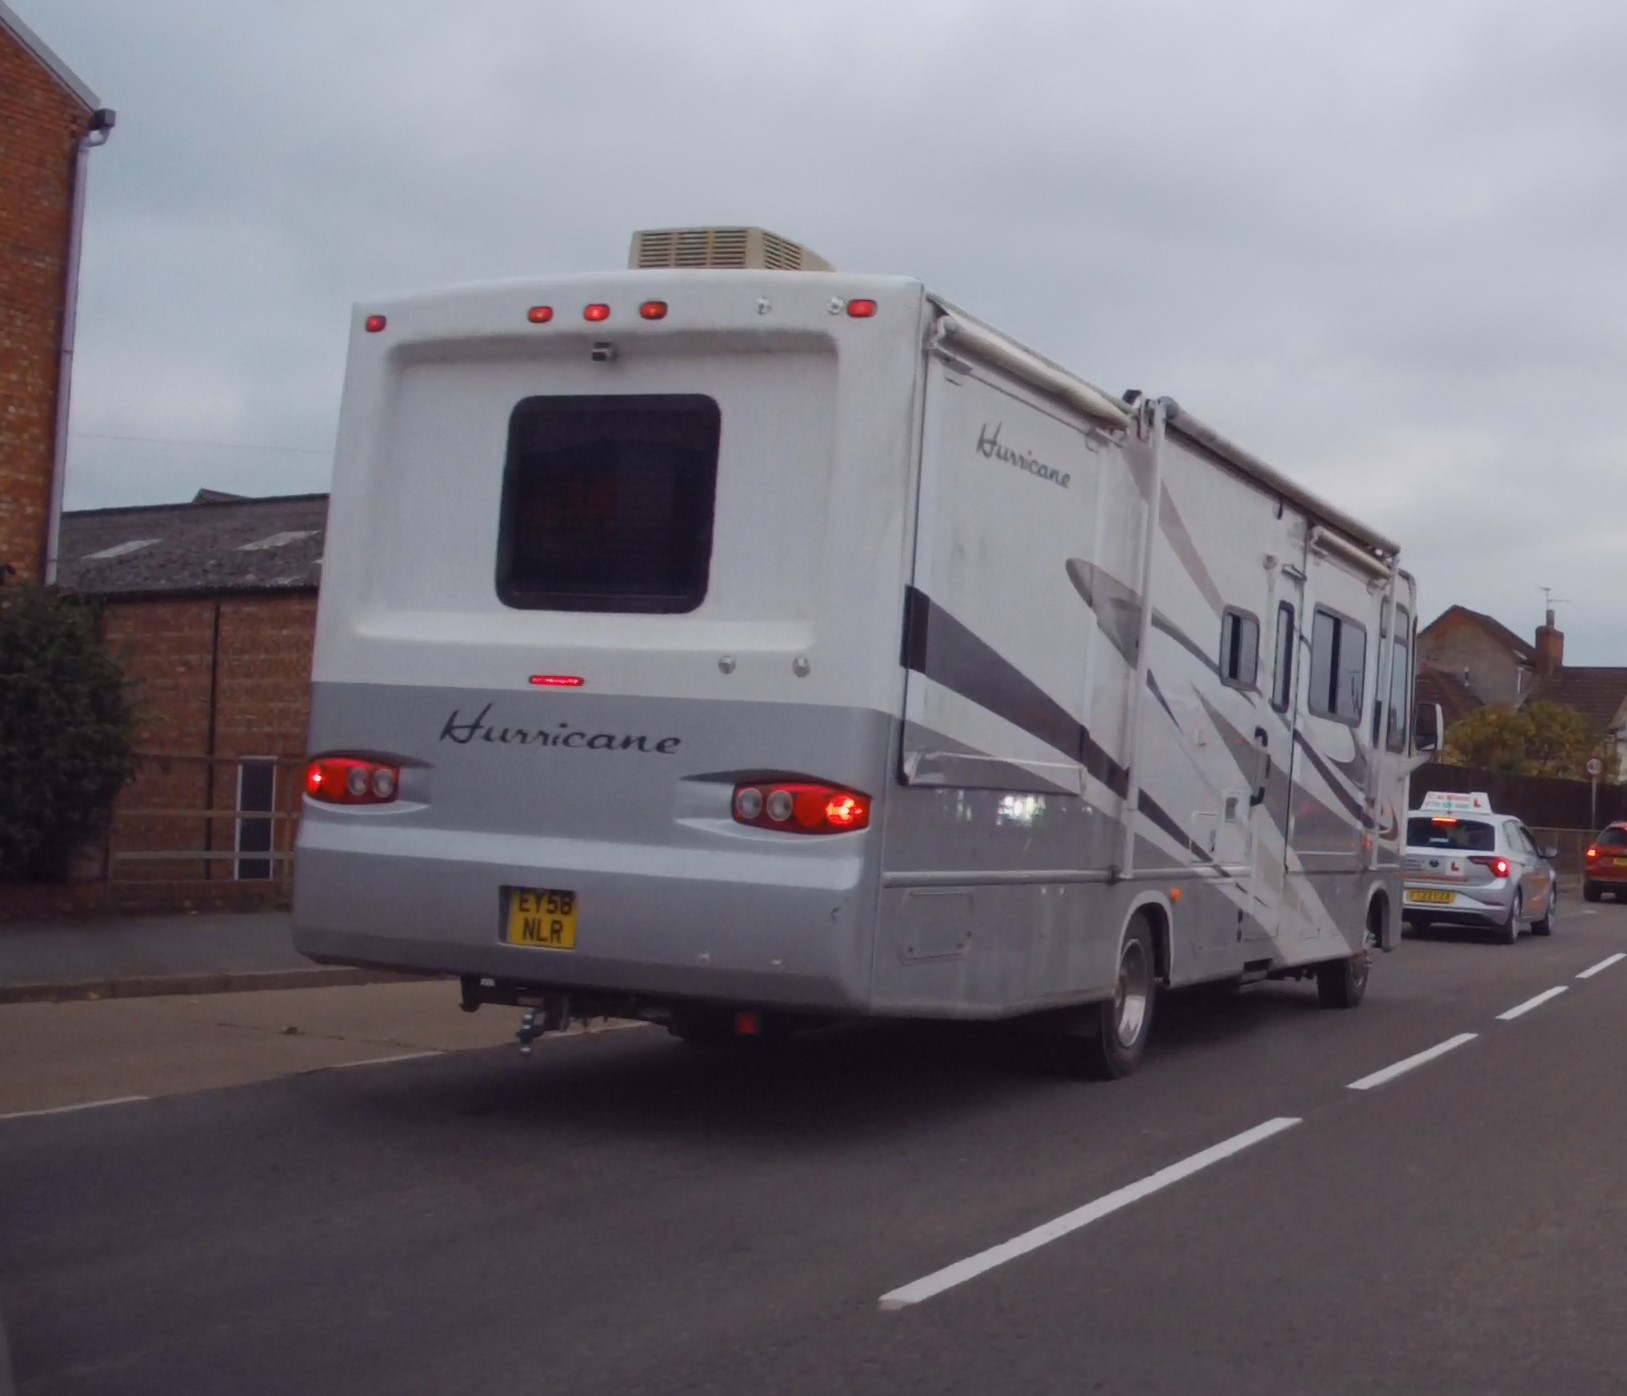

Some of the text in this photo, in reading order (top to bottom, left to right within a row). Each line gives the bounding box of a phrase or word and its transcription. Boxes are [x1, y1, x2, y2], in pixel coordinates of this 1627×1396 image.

[976, 421, 1071, 489] Hurricane
[439, 702, 682, 755] Hurricane
[519, 890, 573, 915] EY58
[522, 917, 563, 944] NLR
